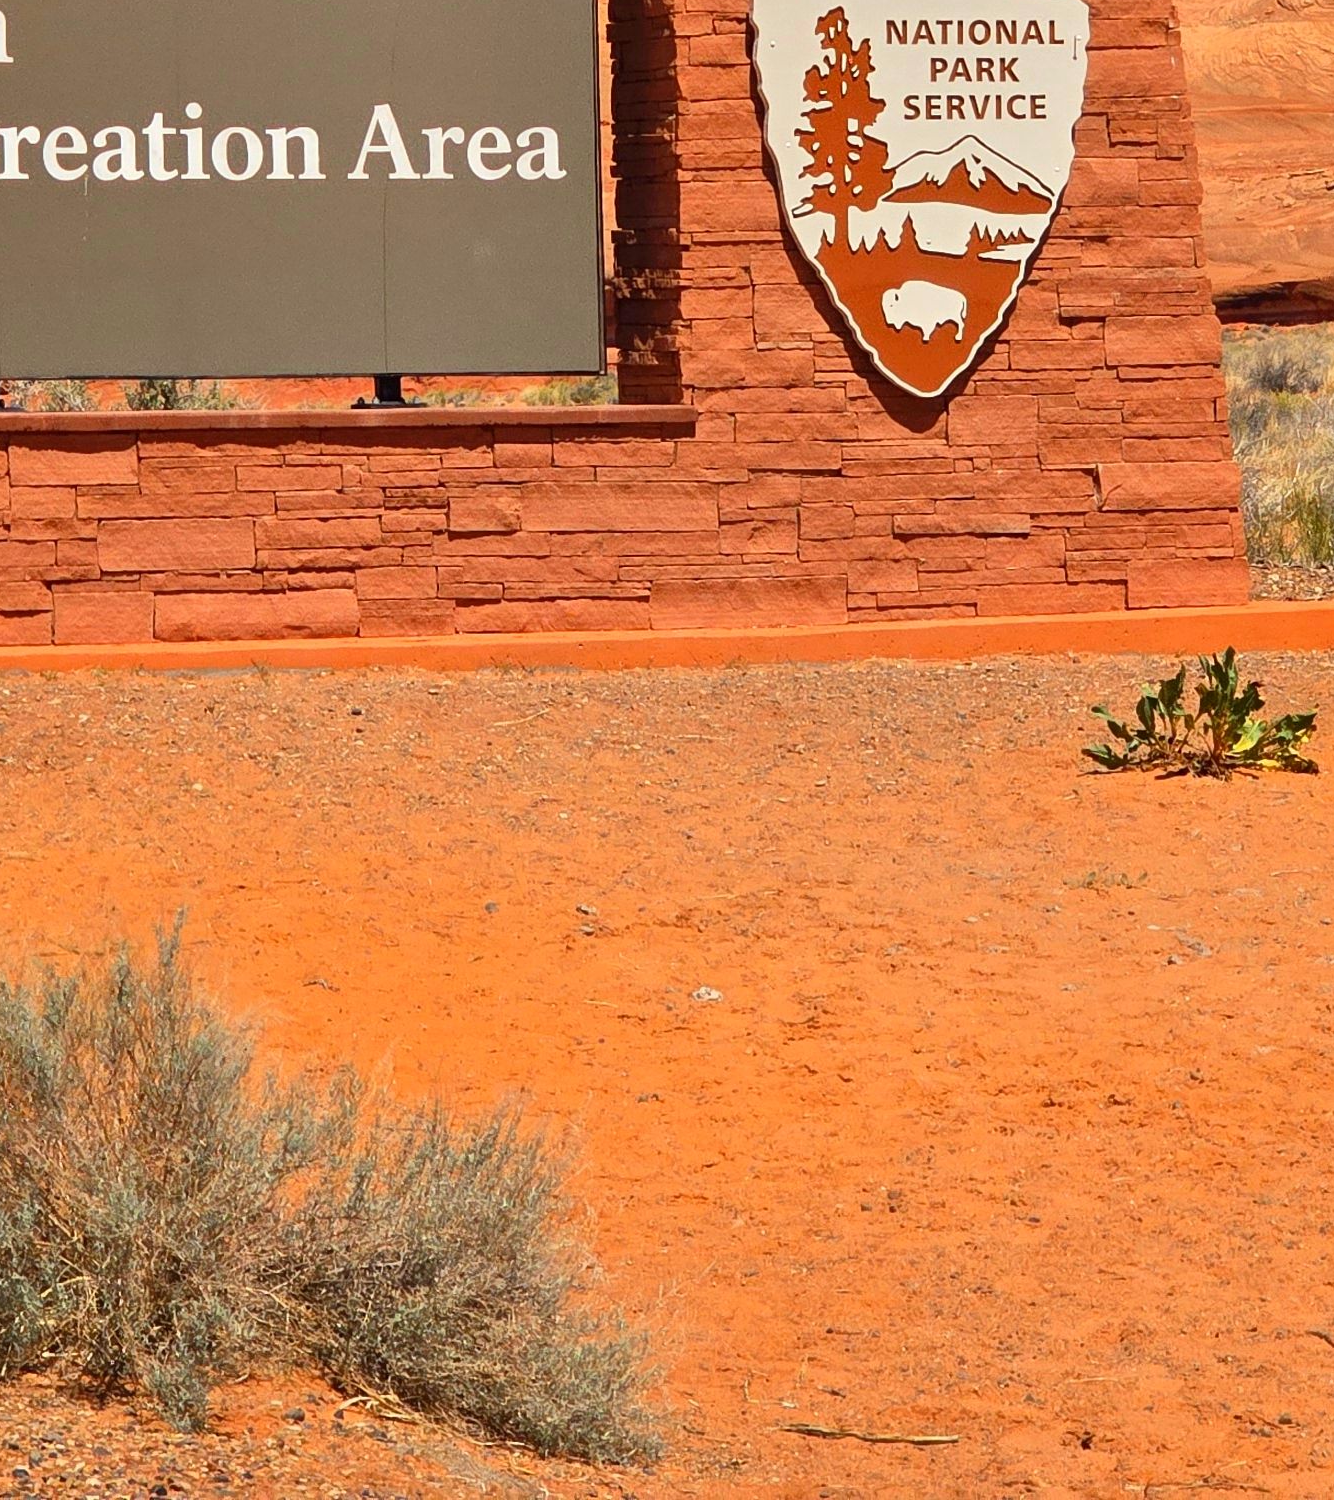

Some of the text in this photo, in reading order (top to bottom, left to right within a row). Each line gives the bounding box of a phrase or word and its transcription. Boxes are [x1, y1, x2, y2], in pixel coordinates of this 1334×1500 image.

[885, 19, 1065, 46] NATIONAL
[930, 57, 1020, 83] PARK
[903, 94, 1047, 121] SERVICE
[347, 103, 568, 181] Area
